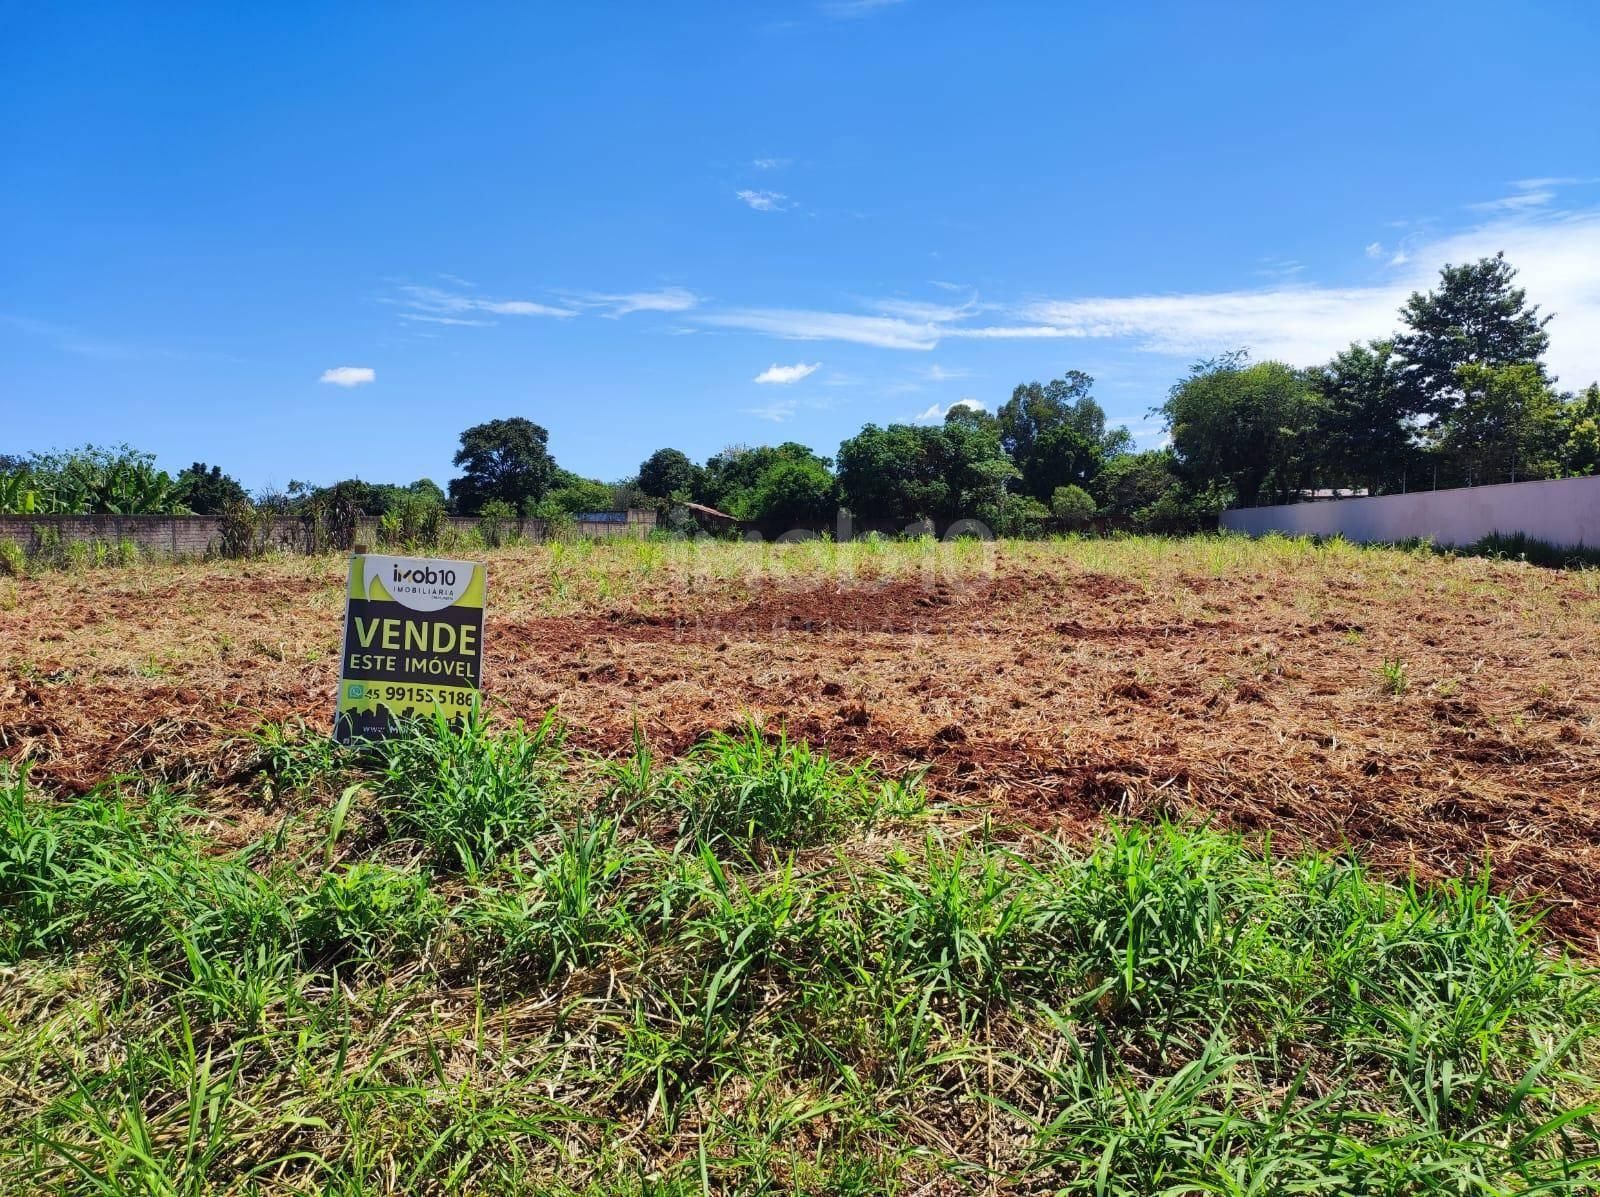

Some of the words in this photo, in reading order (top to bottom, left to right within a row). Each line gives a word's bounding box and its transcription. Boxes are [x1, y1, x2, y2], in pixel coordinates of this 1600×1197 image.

[393, 563, 456, 586] imob10
[354, 616, 477, 656] VENDE
[350, 654, 397, 672] ESTE
[404, 656, 475, 678] IMÓVEL
[364, 688, 381, 700] 45
[385, 686, 435, 703] 99155
[438, 690, 474, 707] 5186
